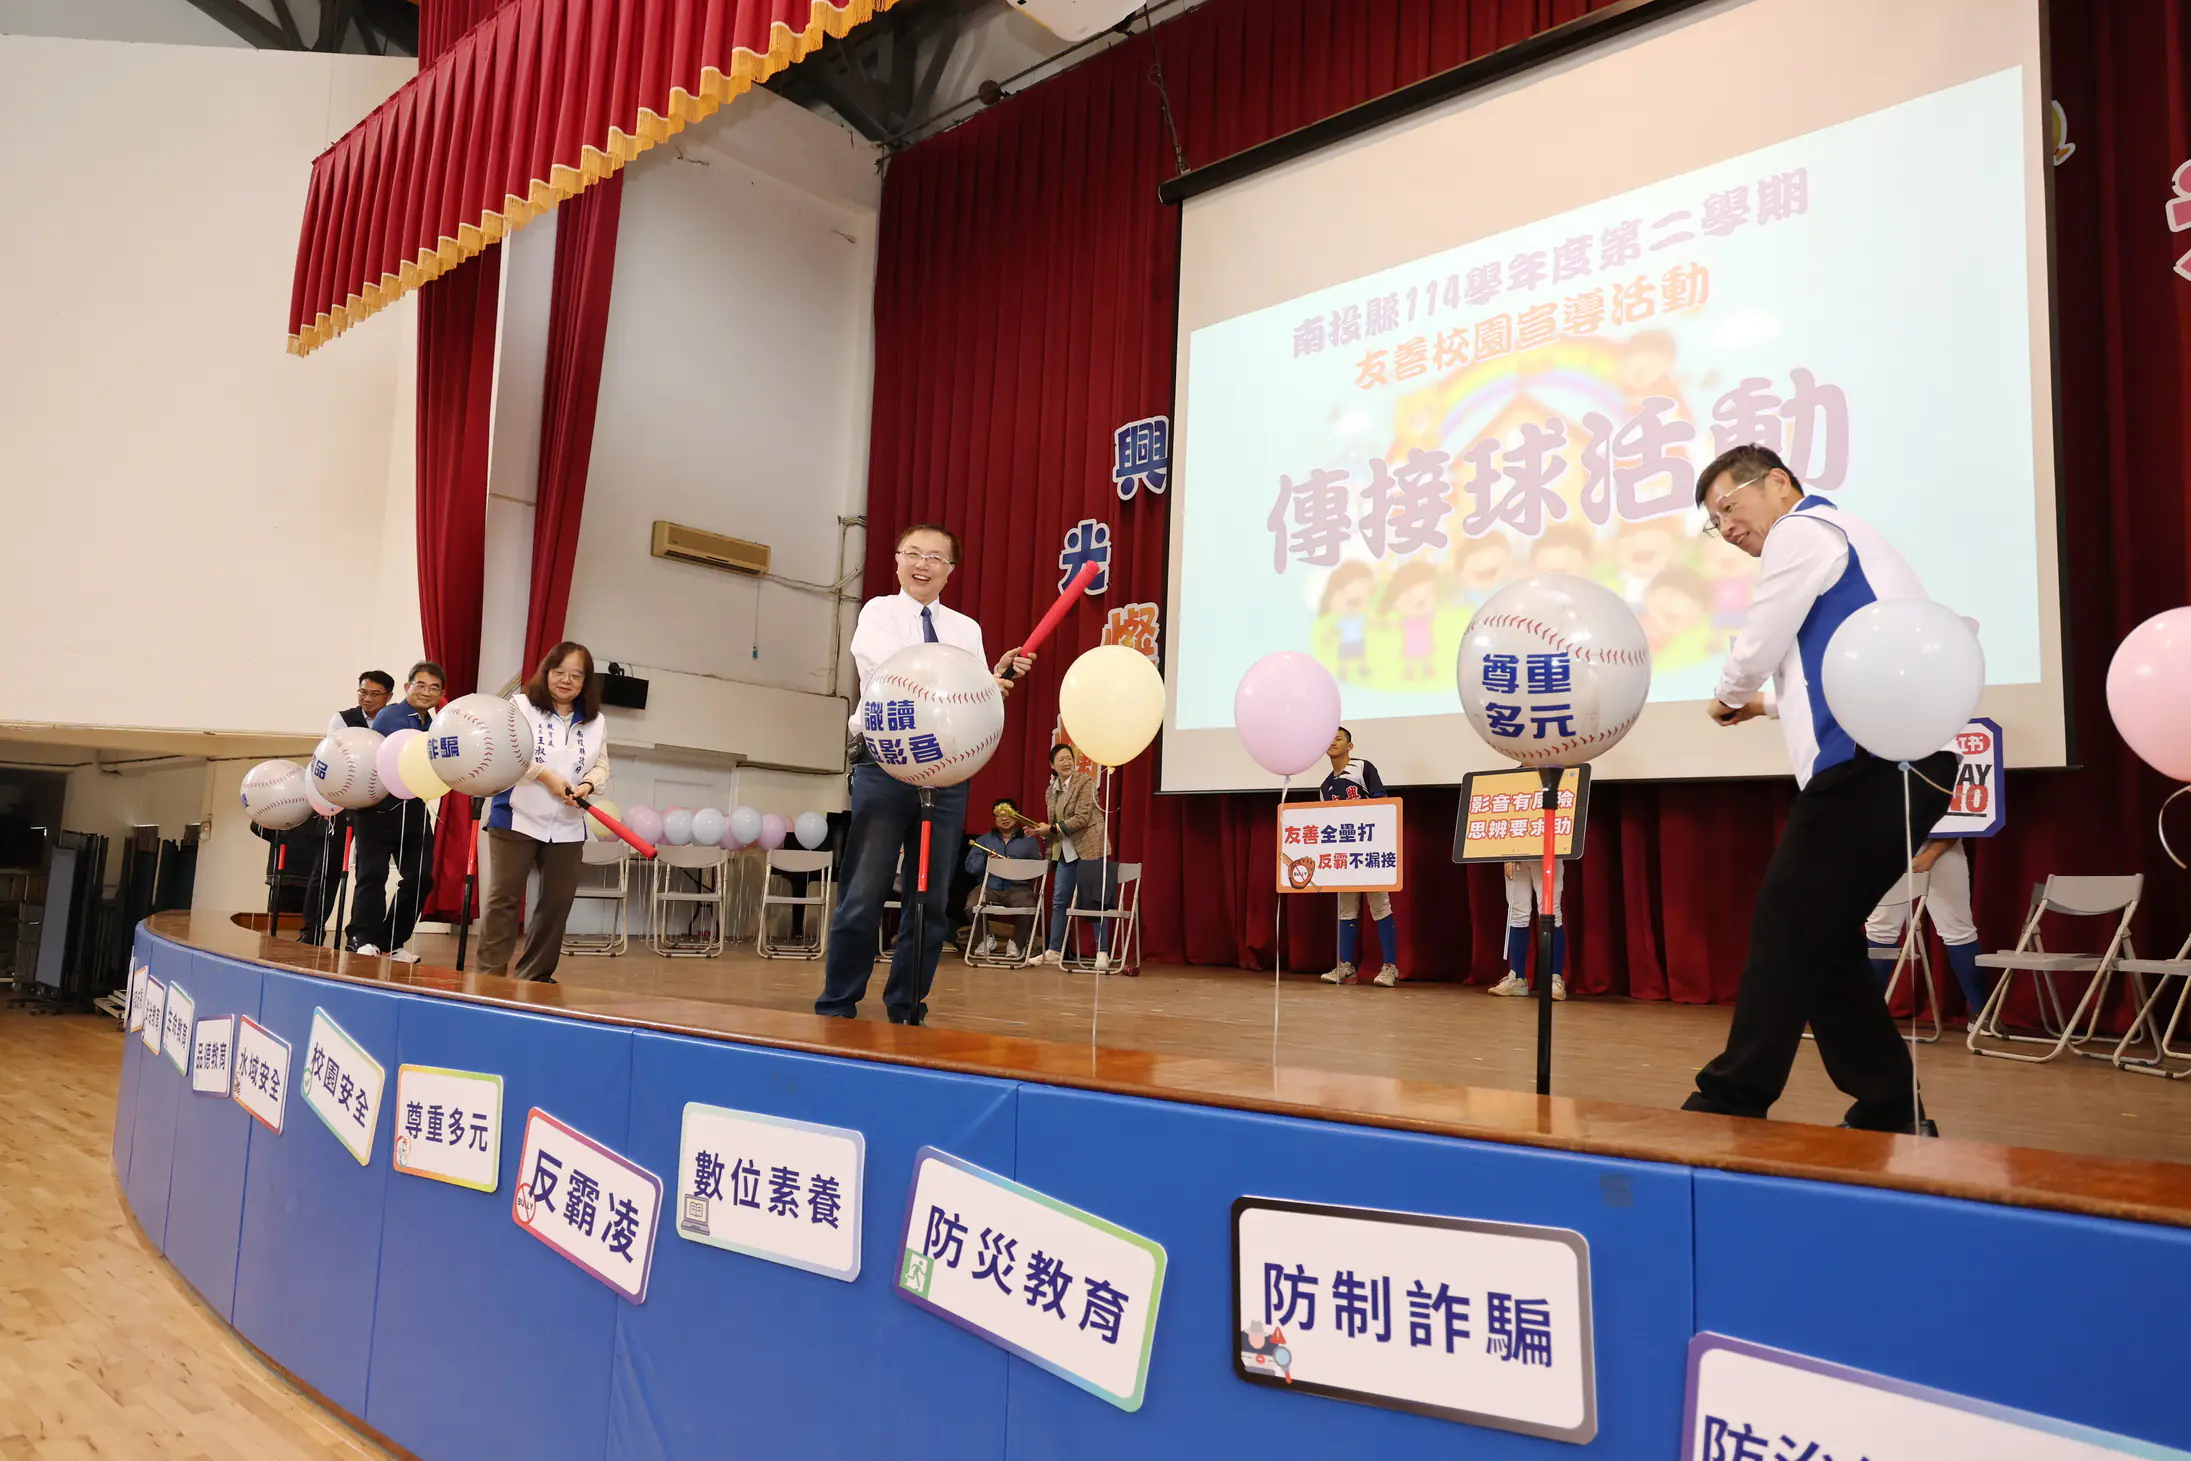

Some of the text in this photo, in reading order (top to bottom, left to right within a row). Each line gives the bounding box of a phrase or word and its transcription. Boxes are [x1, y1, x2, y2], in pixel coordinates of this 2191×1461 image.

[1293, 167, 1808, 359] 南投縣114學年度第二學期
[1355, 261, 1709, 390] 友善校園宣導活動
[1114, 417, 1169, 499] 興
[1267, 368, 1850, 574] 傳接球活動
[1482, 652, 1571, 694] 尊重
[864, 700, 916, 731] 識讀
[1486, 702, 1576, 739] 多元
[1284, 823, 1375, 844] 友善全壘打
[1318, 852, 1396, 869] 反霸不漏接
[239, 1046, 281, 1102] 水域安全
[311, 1042, 369, 1128] 校園安全
[405, 1101, 488, 1152] 尊重多元
[528, 1148, 640, 1263] 反霸凌
[693, 1150, 842, 1230] 數位素養
[923, 1204, 1130, 1345] 防災教育
[1263, 1262, 1553, 1368] 防制詐騙
